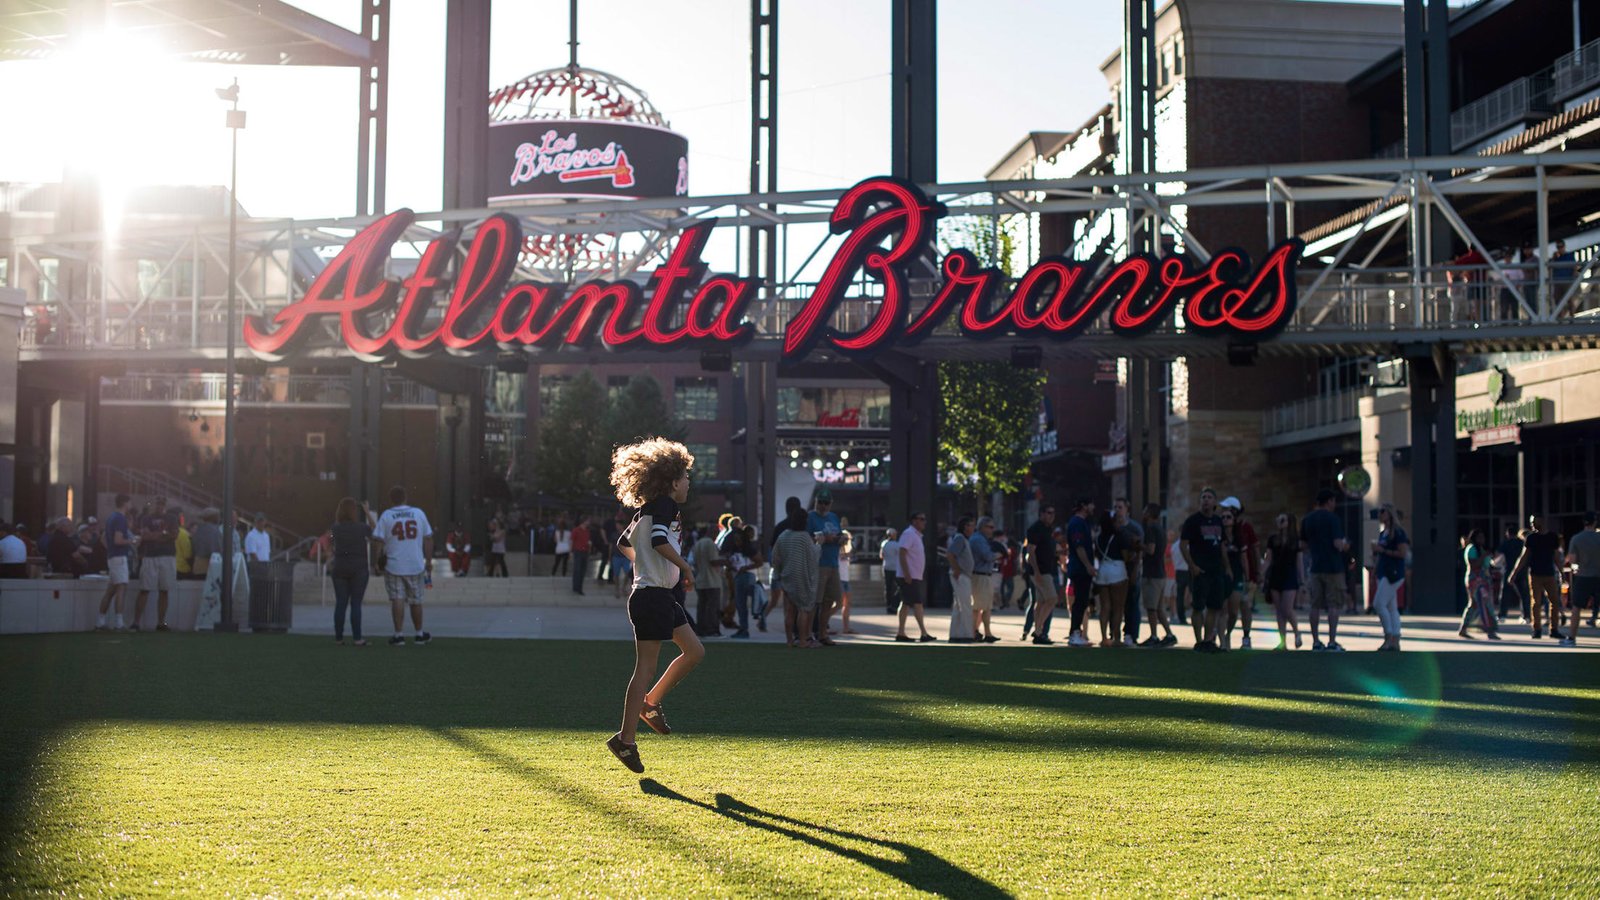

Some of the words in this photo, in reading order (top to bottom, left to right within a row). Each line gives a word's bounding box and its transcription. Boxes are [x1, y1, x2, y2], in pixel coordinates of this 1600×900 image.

[539, 130, 578, 155] Los
[511, 142, 616, 187] Bravos
[242, 207, 762, 356] Atlanta
[782, 175, 1302, 355] Braves
[391, 519, 418, 541] 46
